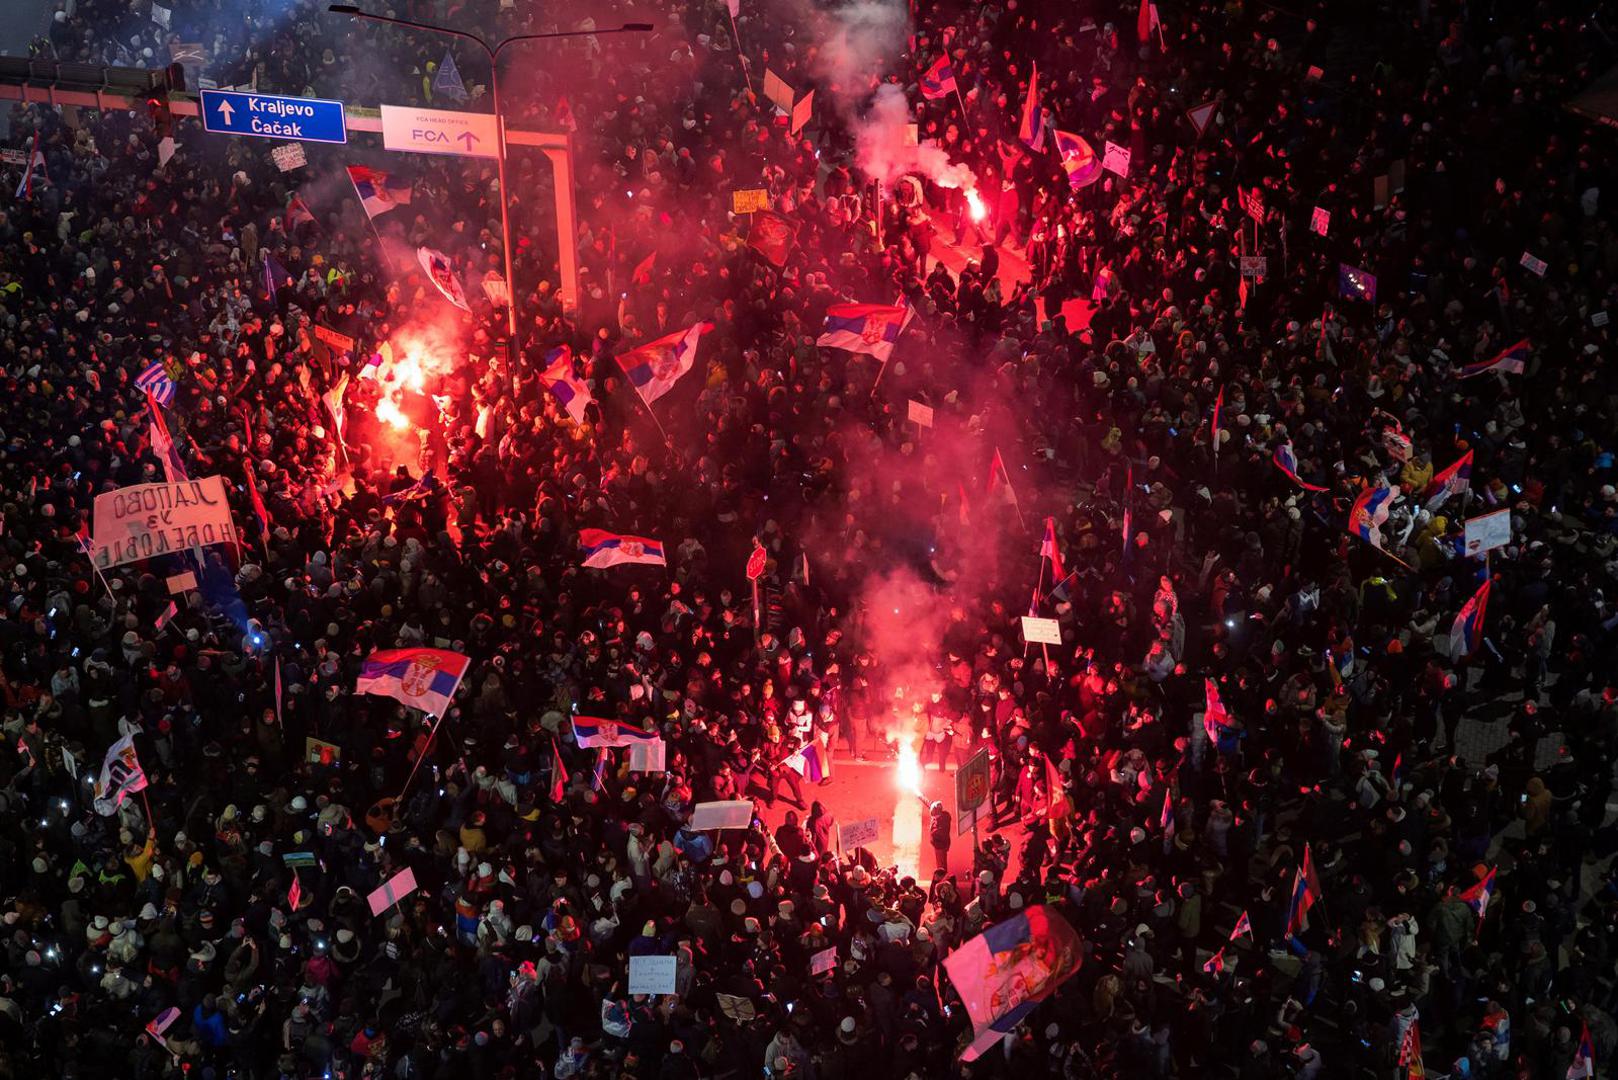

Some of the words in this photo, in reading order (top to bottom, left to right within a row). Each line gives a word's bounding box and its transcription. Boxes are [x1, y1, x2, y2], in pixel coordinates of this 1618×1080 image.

[248, 98, 314, 117] Kraljevo
[251, 116, 302, 136] Čačak
[412, 129, 449, 143] FCA
